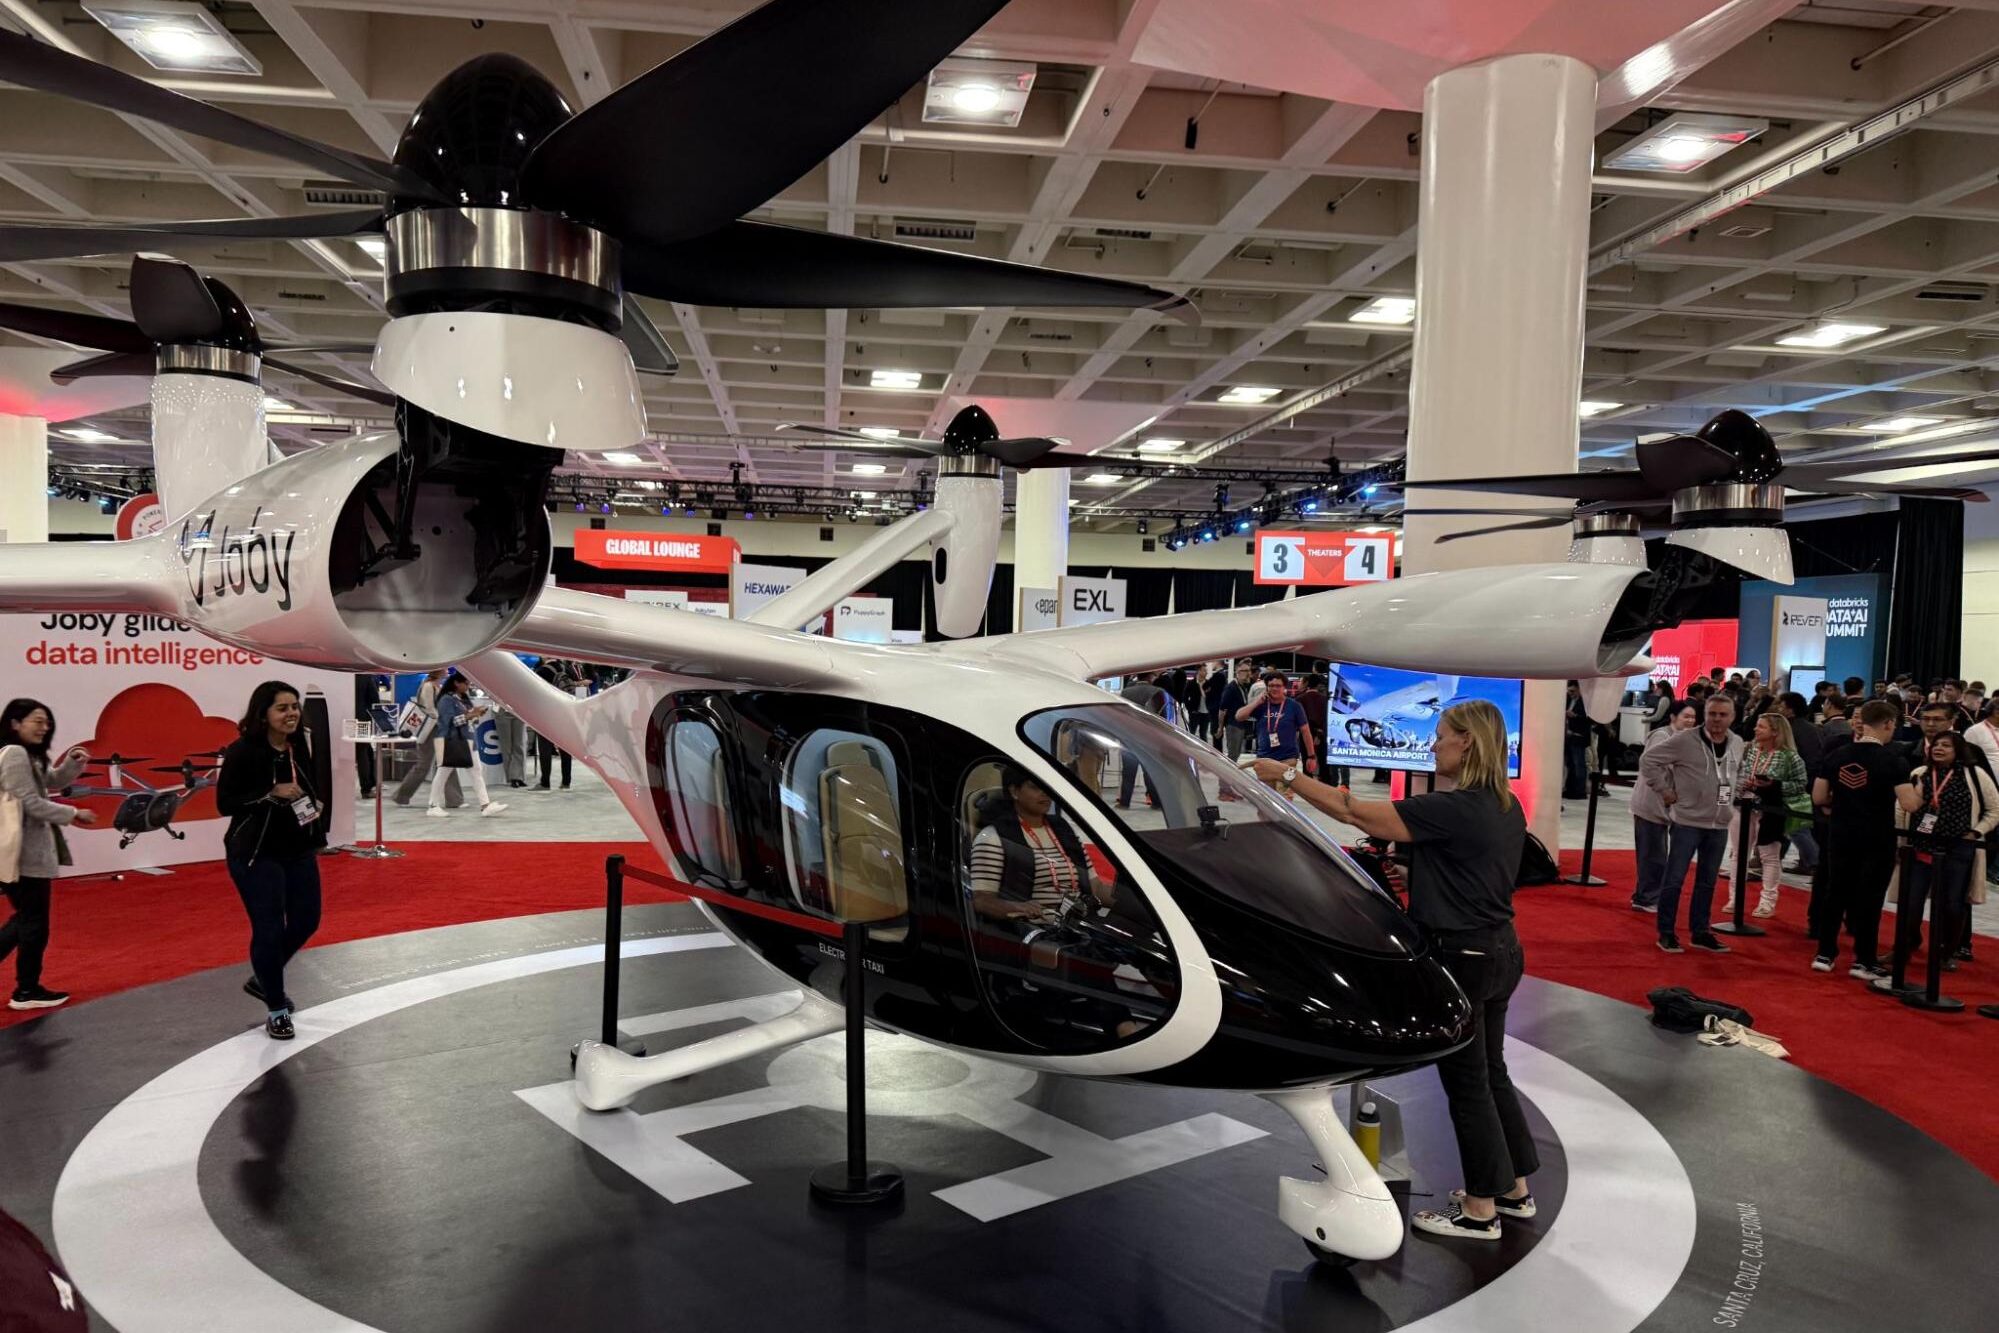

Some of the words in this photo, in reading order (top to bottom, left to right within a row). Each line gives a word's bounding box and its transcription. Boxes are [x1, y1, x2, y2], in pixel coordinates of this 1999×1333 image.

[213, 506, 296, 611] Joby
[606, 539, 652, 556] GLOBAL
[653, 540, 701, 558] LOUNGE
[1273, 543, 1288, 573] 3
[1307, 549, 1343, 557] THEATERS
[1361, 545, 1376, 574] 4
[1074, 588, 1115, 612] EXL
[1829, 597, 1869, 608] databricks
[40, 613, 116, 637] Joby
[1826, 624, 1867, 637] UMMIT
[26, 641, 97, 665] data
[105, 641, 264, 671] intelligence
[1332, 747, 1360, 755] SANTA
[1360, 749, 1392, 758] MONICA
[1393, 751, 1429, 760] AIRPORT
[818, 942, 846, 960] ELECTR
[866, 960, 885, 974] TAXI
[1736, 1202, 1764, 1258] CALIFORNIA
[1733, 1260, 1767, 1290] CRUZ,
[1712, 1291, 1754, 1327] SANTA
